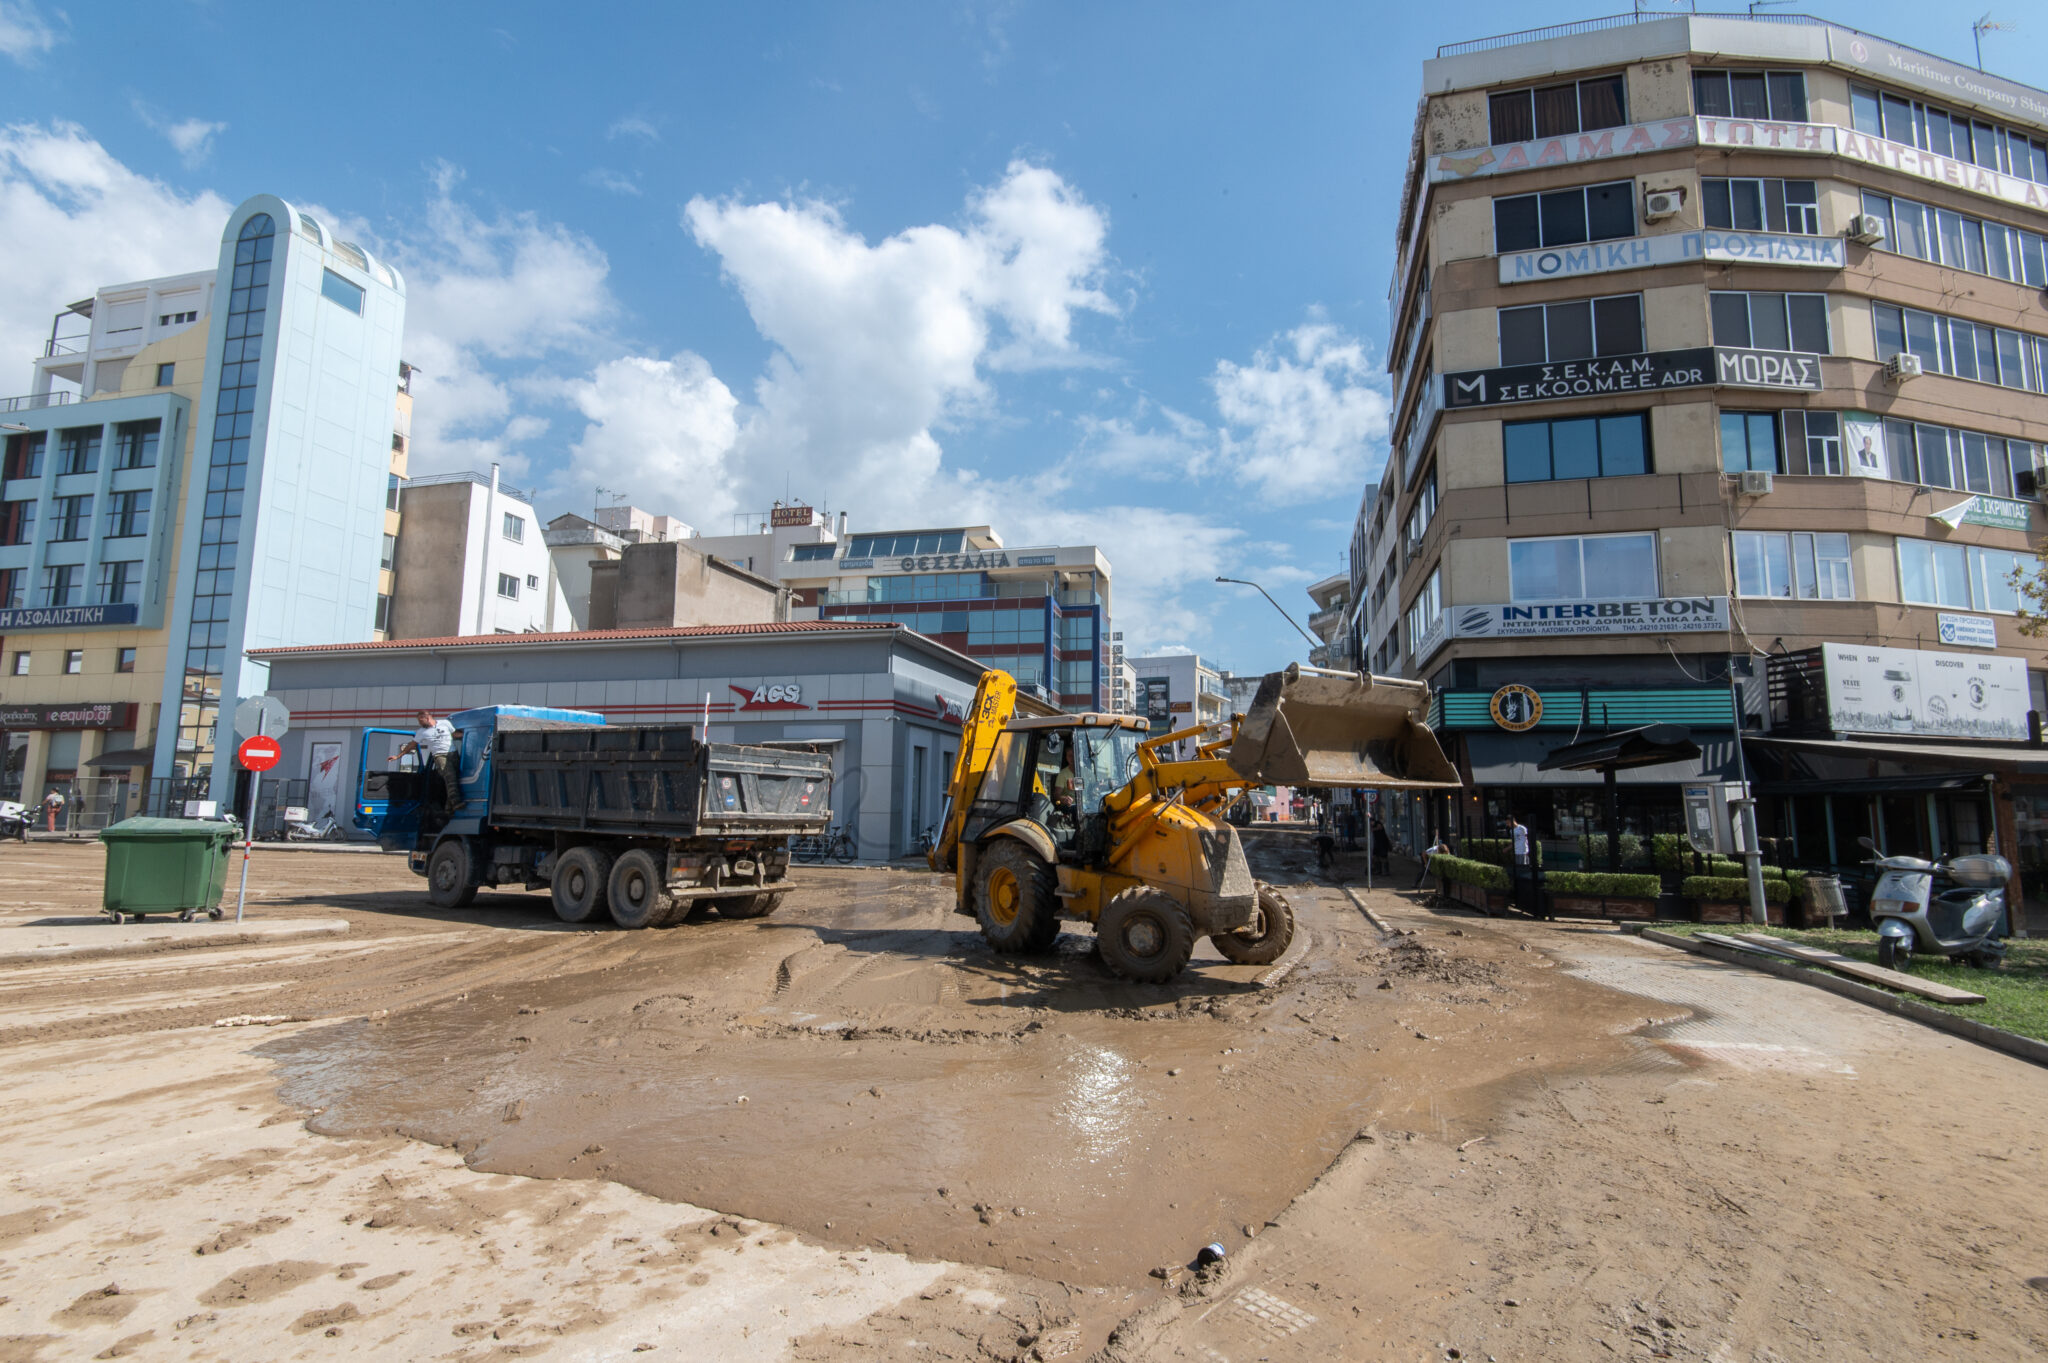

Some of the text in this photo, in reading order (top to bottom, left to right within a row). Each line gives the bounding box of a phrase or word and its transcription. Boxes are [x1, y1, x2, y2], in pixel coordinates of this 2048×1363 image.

[1888, 54, 1951, 84] Maritime
[1954, 74, 2017, 108] Company
[1498, 120, 1823, 169] ΔΑΜΑΣΙΩΤΗ
[1515, 233, 1837, 278] ΝΟΜΙΚΗ ΠΡΟΣΤΑΣΙΑ
[1542, 357, 1654, 381] Σ.Ε.Κ.Α.Μ.
[1662, 368, 1703, 385] ADR
[1718, 352, 1816, 388] ΜΟΡΑΣ
[774, 508, 810, 518] HOTEL
[900, 552, 1010, 572] ΘΕΣΣΑΛΙΑ
[15, 607, 104, 626] ΑΣΦΑΛΙΣΤΙΚΗ
[1503, 600, 1714, 620] INTERBETON
[1497, 626, 1537, 635] ΣΚΥΡΟΔΕΜΑ
[1541, 626, 1575, 634] ΛΑΤΟΜΙΚΑ
[1502, 619, 1590, 628] ΙΝΤΕΡΜΠΕΤΟΝ
[1595, 617, 1645, 625] ΔΟΜΙΚΑ
[1650, 615, 1689, 623] ΥΛΙΚΑ
[1838, 653, 1858, 662] WHEN
[1867, 655, 1880, 663] DAY
[1935, 660, 1964, 668] DISCOVER
[750, 685, 801, 703] ACS
[982, 693, 995, 719] 3CX
